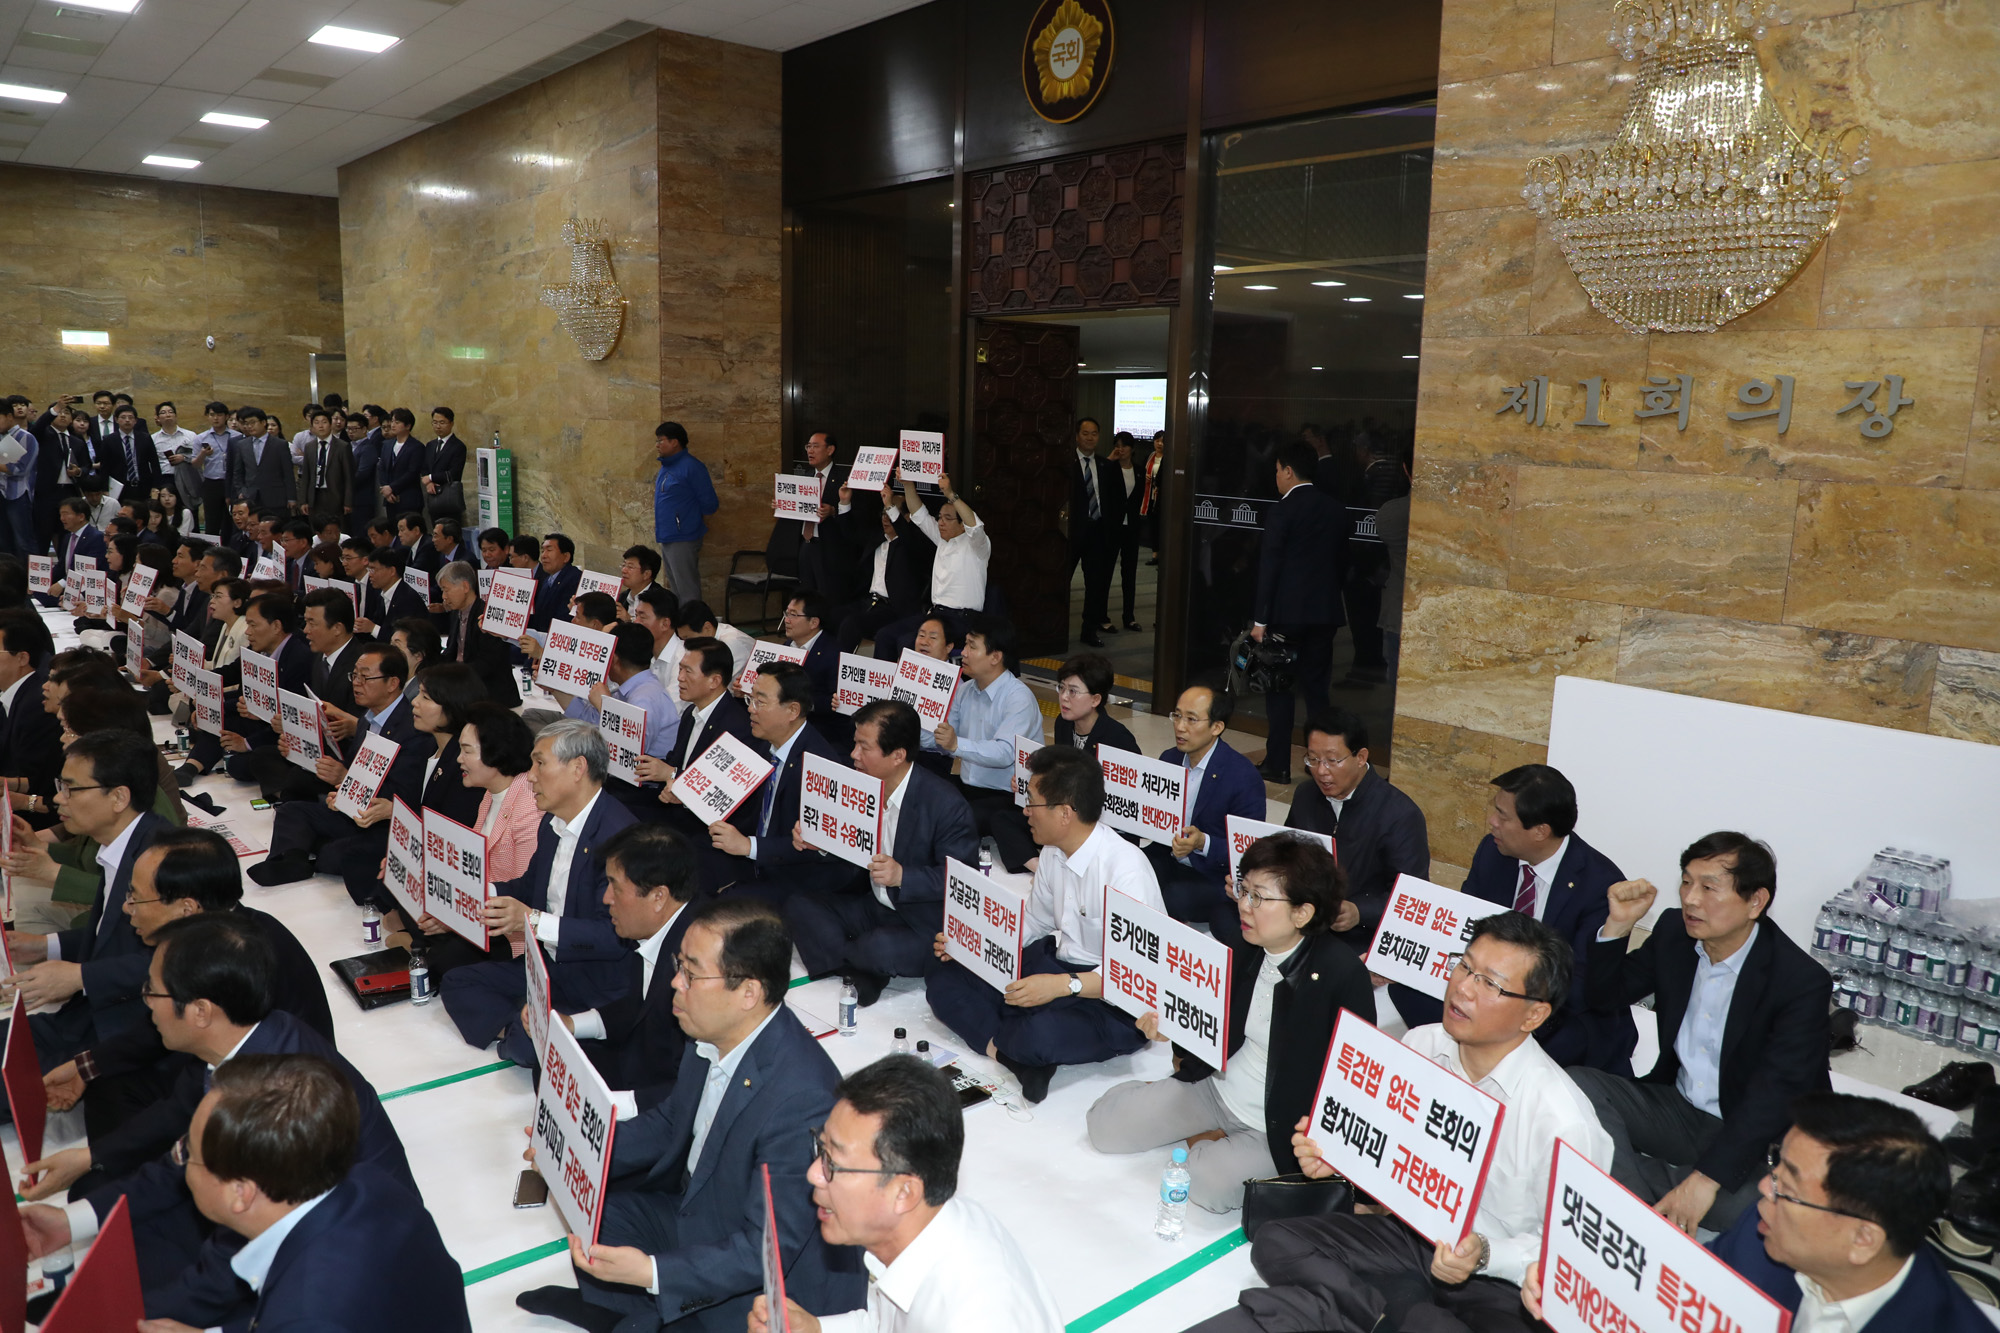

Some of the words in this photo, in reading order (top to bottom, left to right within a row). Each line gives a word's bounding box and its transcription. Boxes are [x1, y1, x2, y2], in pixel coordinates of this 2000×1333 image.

[1052, 38, 1080, 67] 국회
[1496, 374, 1914, 438] 제1회의장
[902, 440, 920, 453] 특검법안
[922, 441, 941, 454] 처리거부
[798, 485, 818, 497] 부실수사
[542, 658, 557, 676] 즉각
[558, 662, 572, 680] 특검
[550, 632, 578, 654] 청와대와
[578, 640, 608, 663] 민주당은
[842, 664, 866, 684] 증거인멸
[900, 660, 919, 680] 특검법
[918, 666, 932, 686] 없는
[932, 672, 954, 694] 본회의
[840, 688, 864, 708] 특검으로
[917, 696, 944, 721] 규탄한다
[602, 710, 621, 734] 증거인멸
[622, 717, 642, 742] 부실수사
[682, 767, 712, 796] 특검으로
[704, 786, 735, 816] 규명하라
[704, 744, 736, 772] 증거인멸
[727, 762, 759, 792] 부실수사
[1102, 760, 1138, 788] 특검법안
[1142, 772, 1180, 800] 처리거부
[806, 770, 838, 804] 청와대와
[842, 784, 876, 817] 민주당은
[804, 805, 819, 831] 즉각
[822, 813, 838, 839] 특검
[840, 824, 874, 855] 수용하라
[1142, 804, 1180, 834] 반대인가?
[428, 830, 444, 862] 특검법
[447, 840, 460, 871] 없는
[462, 849, 482, 884] 본회의
[427, 870, 452, 909] 협치파괴
[454, 888, 482, 928] 규탄한다
[948, 875, 980, 916] 댓글공작
[983, 896, 1016, 938] 특검거부
[1393, 893, 1432, 922] 특검법
[1430, 905, 1458, 936] 없는
[947, 914, 982, 957] 문재인정권
[984, 938, 1014, 980] 규탄한다
[1110, 912, 1160, 964] 증거인멸
[1166, 941, 1220, 998] 부실수사
[1377, 930, 1430, 972] 협치파괴
[1109, 958, 1158, 1010] 특검으로
[1164, 989, 1219, 1047] 규명하라
[547, 1041, 568, 1101] 특검법
[566, 1072, 582, 1124] 없는
[580, 1096, 606, 1162] 본회의
[1336, 1042, 1385, 1100] 특검법
[1386, 1074, 1421, 1124] 없는
[1424, 1098, 1482, 1164] 본회의
[537, 1098, 565, 1172] 협치파괴
[564, 1146, 596, 1226] 규탄한다
[1320, 1096, 1388, 1169] 협치파괴
[1390, 1144, 1464, 1224] 규탄한다
[1561, 1184, 1646, 1292] 댓글공작
